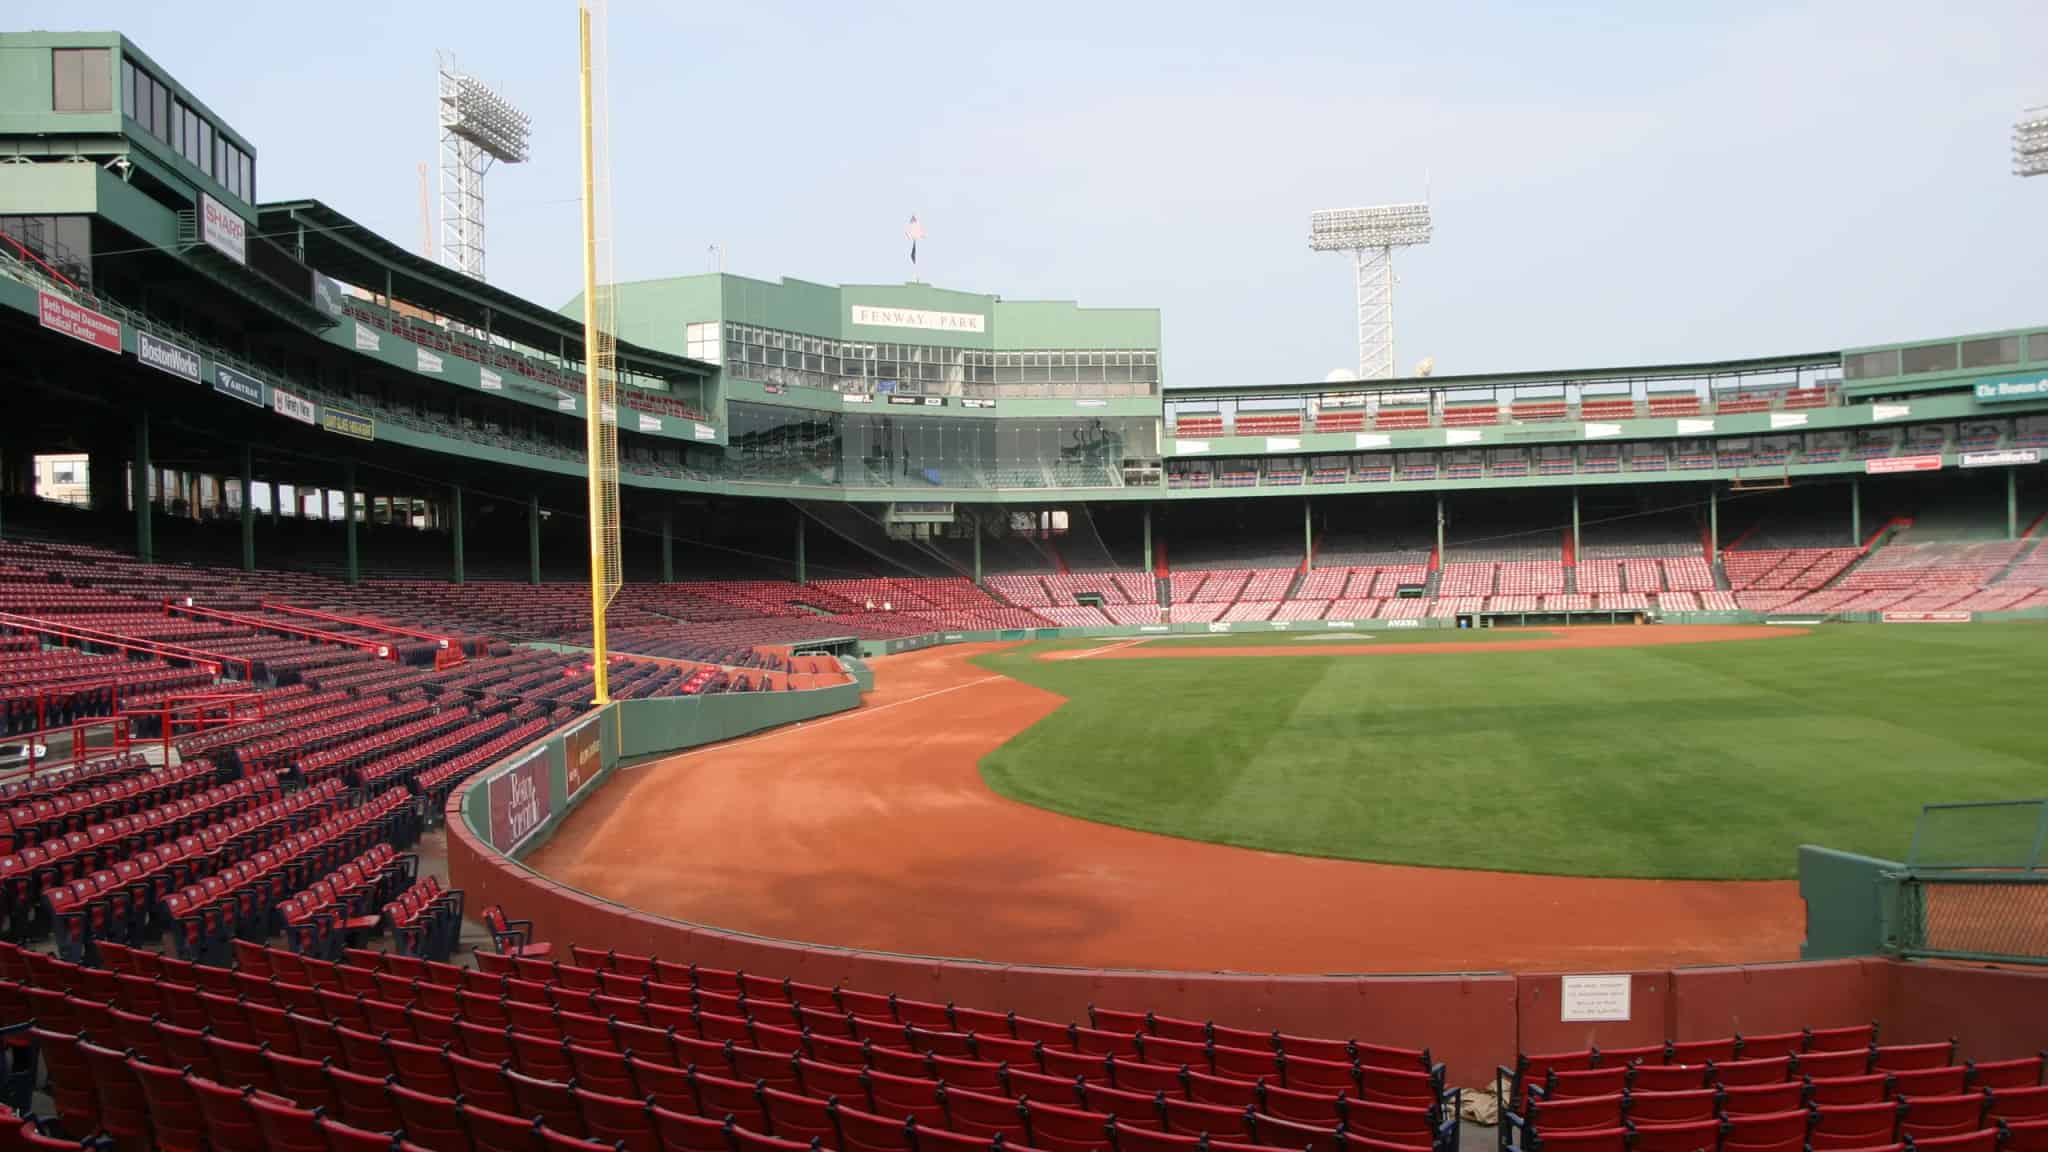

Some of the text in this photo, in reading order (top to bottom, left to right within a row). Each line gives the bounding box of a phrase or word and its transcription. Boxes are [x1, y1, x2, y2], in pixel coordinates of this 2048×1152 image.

[206, 203, 242, 238] SHARP
[861, 310, 977, 329] FENWAY PARK
[141, 337, 198, 377] BostonWorks
